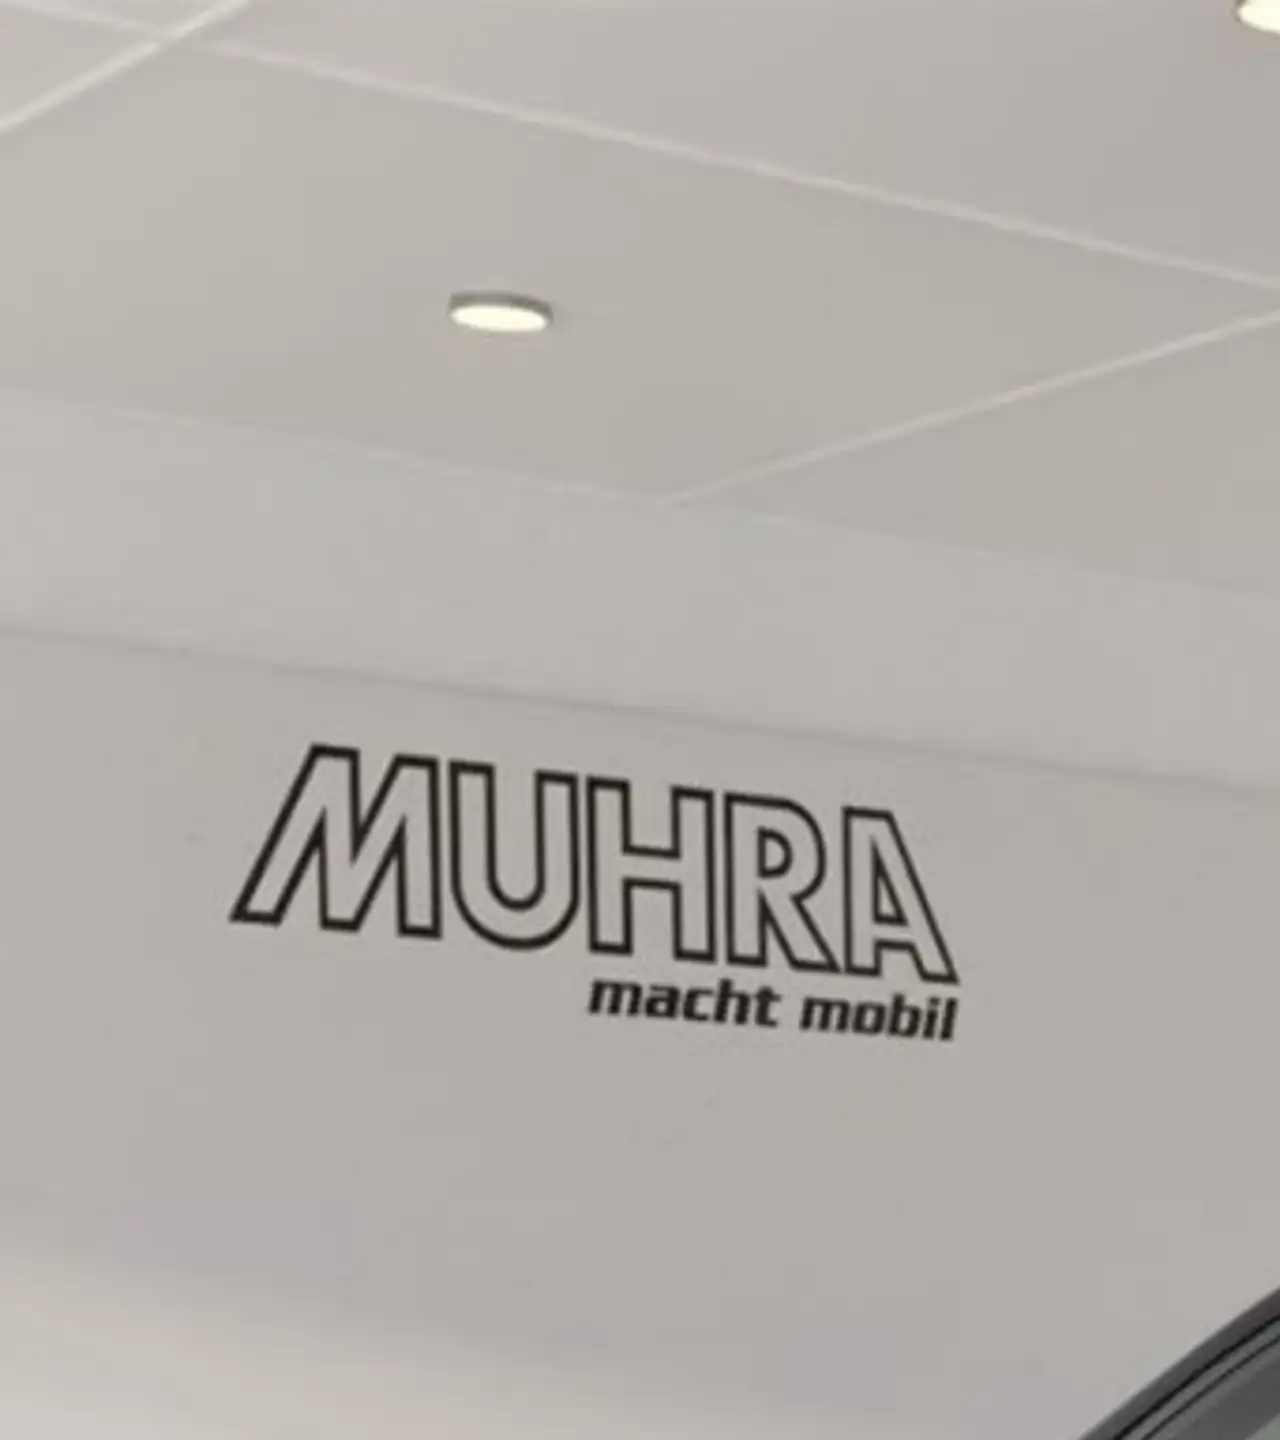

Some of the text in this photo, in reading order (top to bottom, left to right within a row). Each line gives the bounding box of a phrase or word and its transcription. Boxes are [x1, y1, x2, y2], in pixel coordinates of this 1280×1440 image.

[229, 743, 959, 985] MUHRA
[588, 978, 958, 1041] macht mobil
